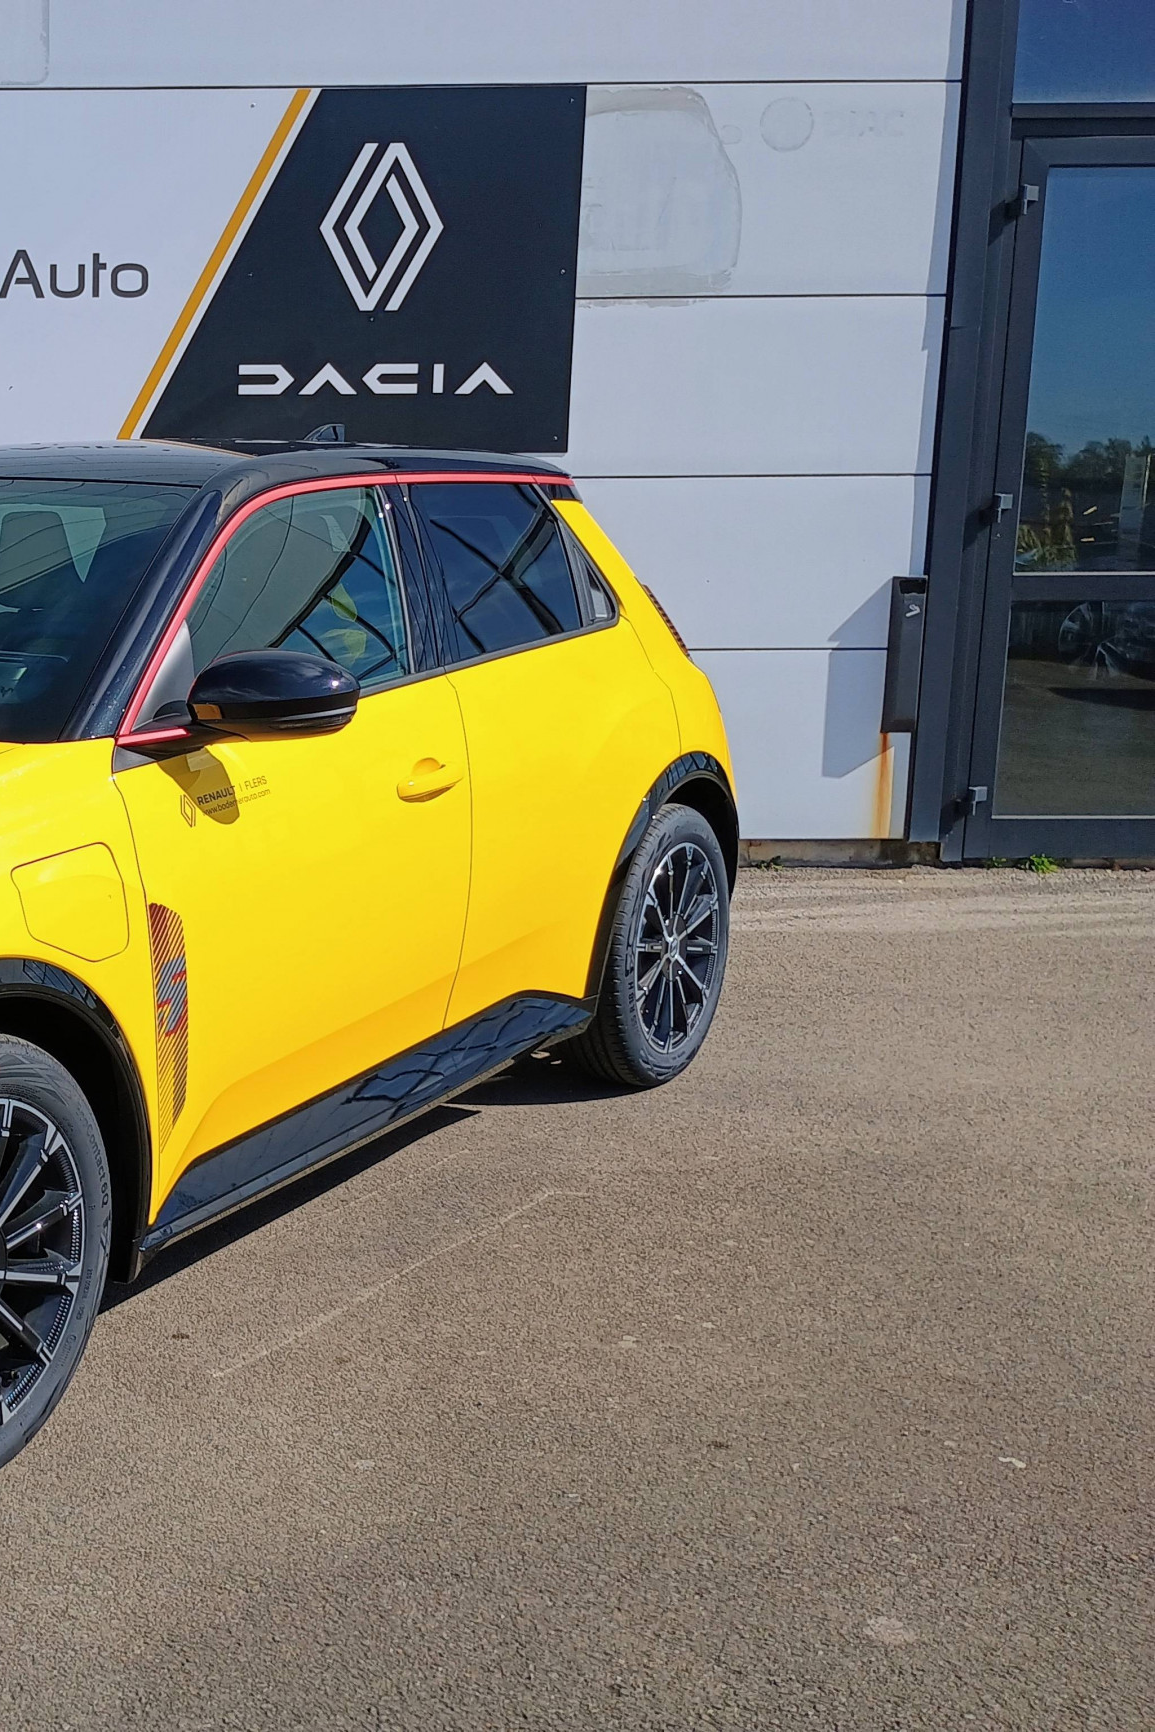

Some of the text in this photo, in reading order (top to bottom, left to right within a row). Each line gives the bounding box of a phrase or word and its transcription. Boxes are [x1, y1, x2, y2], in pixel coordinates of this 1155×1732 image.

[237, 361, 515, 396] DACIA
[197, 785, 236, 806] RENAULT
[244, 775, 268, 790] FLERS
